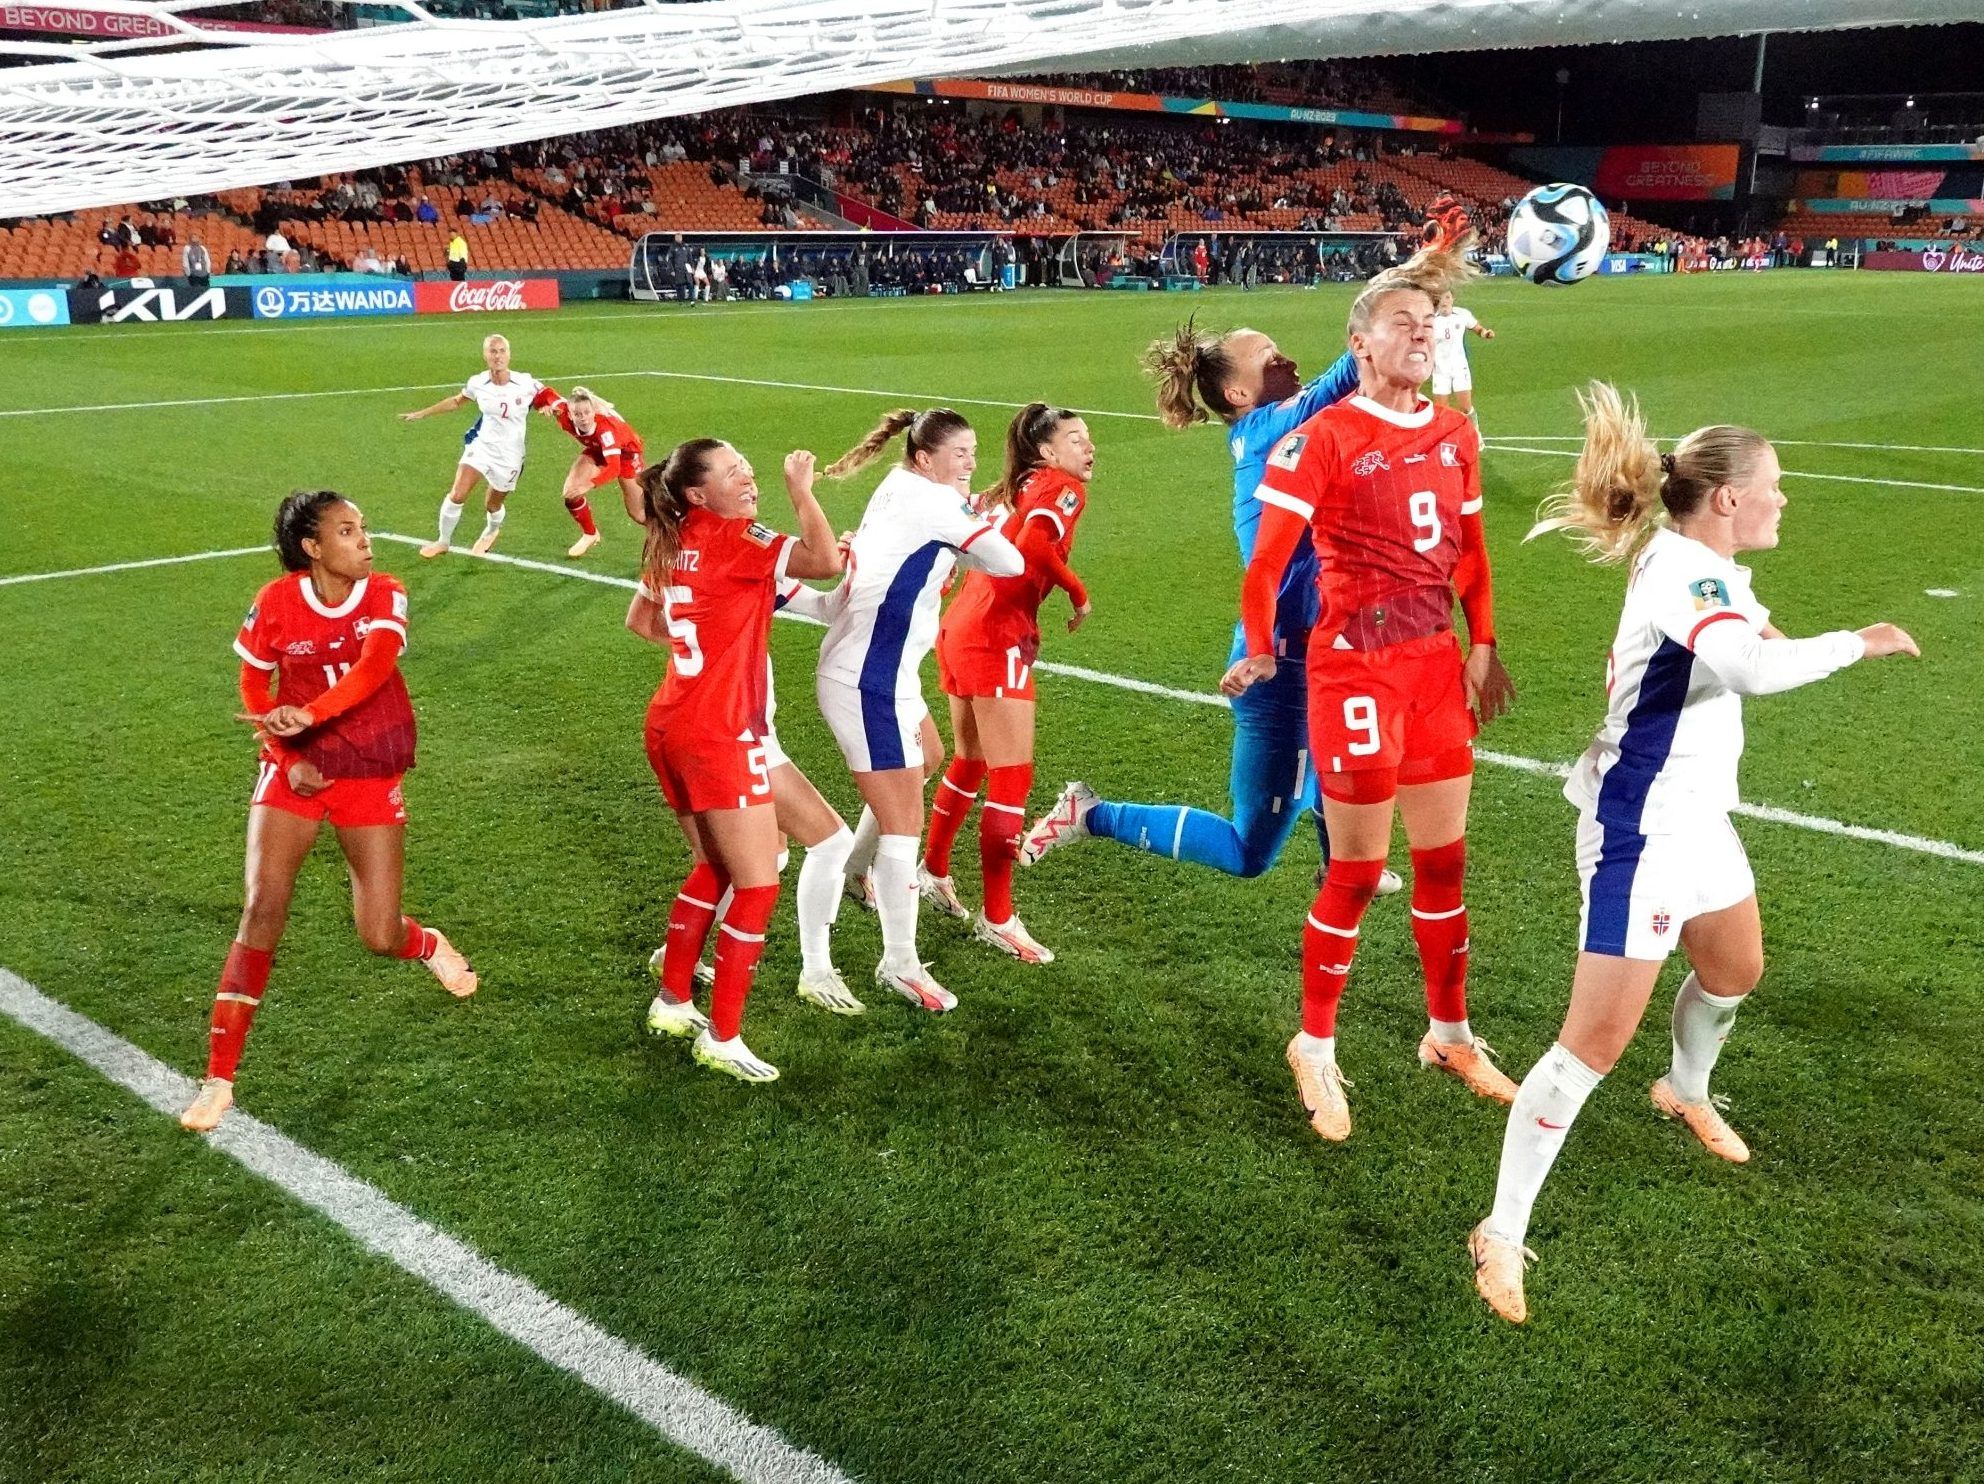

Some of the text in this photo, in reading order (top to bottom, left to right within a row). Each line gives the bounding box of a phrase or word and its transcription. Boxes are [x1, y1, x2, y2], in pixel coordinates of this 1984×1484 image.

[5, 9, 97, 30] BEYOND
[987, 85, 1113, 105] FIFA WOMEN'S WORLD CUP
[1640, 160, 1702, 173] BEYOND
[1625, 175, 1715, 187] GREATNESS
[1610, 259, 1627, 273] VISA
[1949, 252, 1984, 273] Unite
[1444, 327, 1451, 340] 8
[499, 402, 509, 419] 2
[508, 470, 518, 483] 2
[1408, 490, 1442, 553] 9
[662, 585, 704, 677] 5
[1342, 695, 1382, 757] 9
[746, 745, 771, 796] 5
